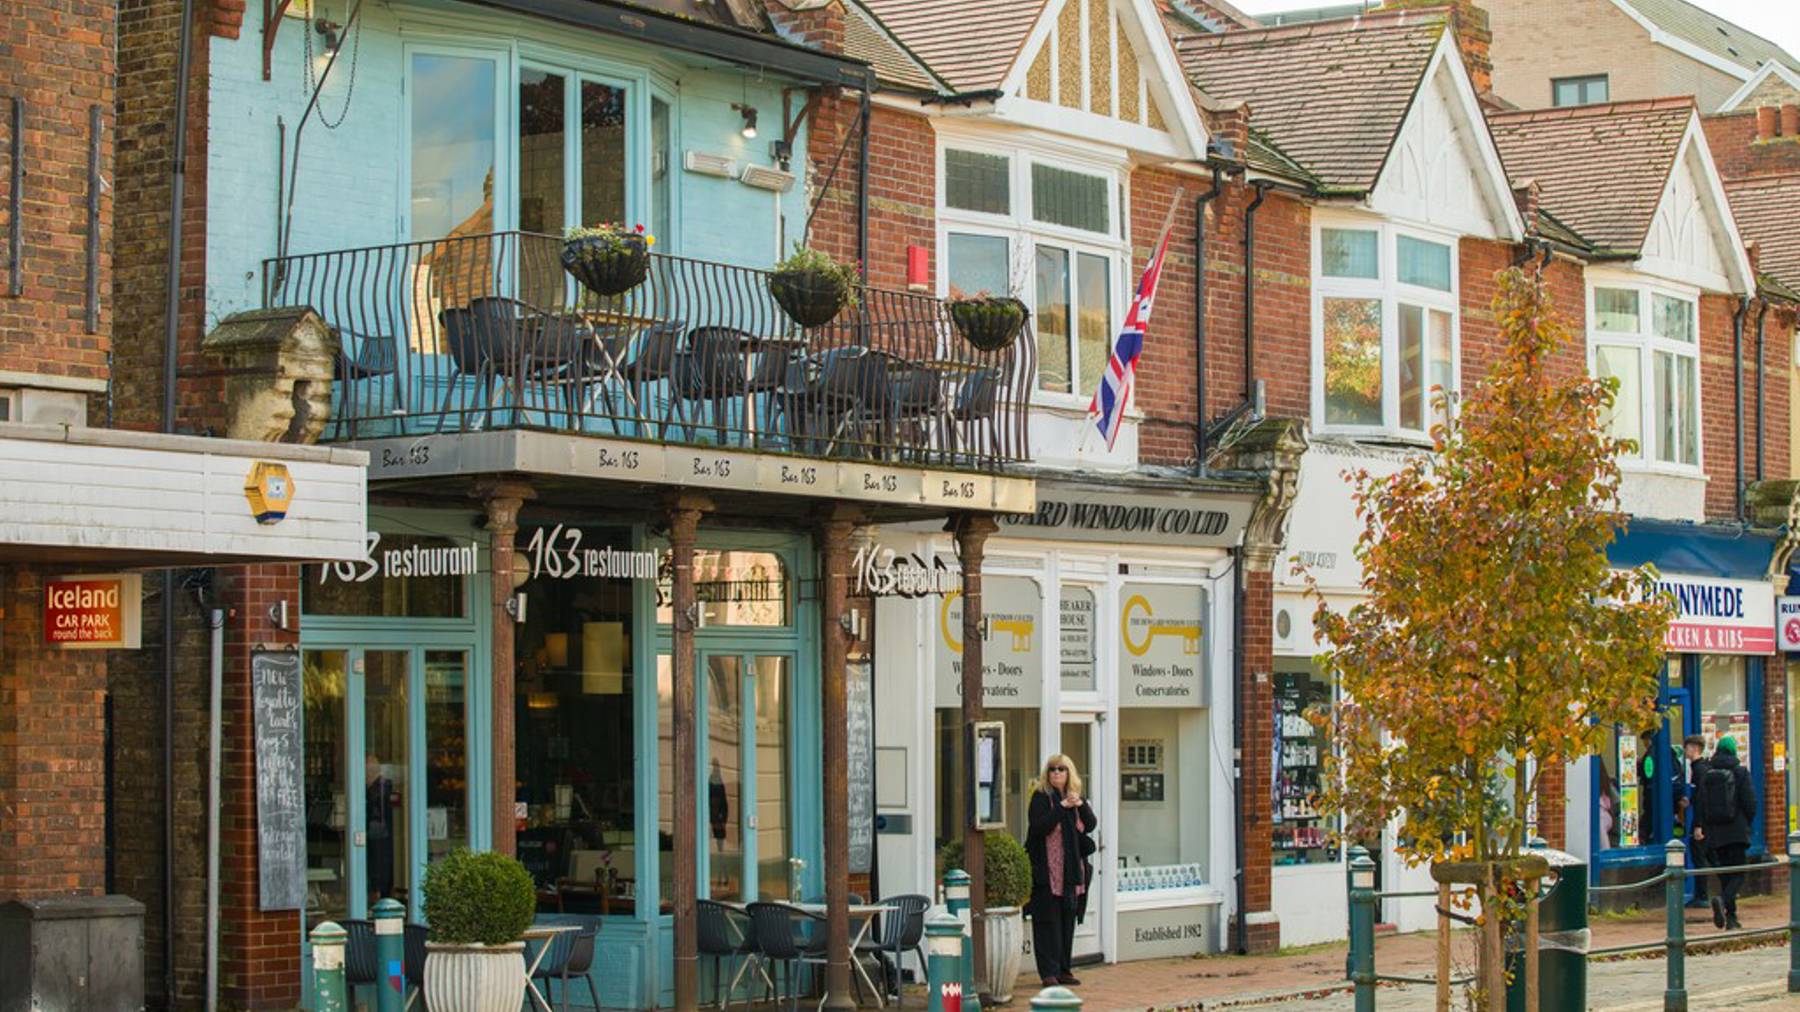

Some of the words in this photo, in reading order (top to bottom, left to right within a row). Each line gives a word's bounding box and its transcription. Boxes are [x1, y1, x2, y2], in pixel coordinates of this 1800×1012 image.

[382, 449, 404, 467] Bar
[410, 447, 430, 464] 163
[599, 449, 619, 468] Bar
[622, 451, 640, 470] 163
[693, 458, 712, 476] Bar
[715, 459, 731, 478] 163
[781, 466, 799, 483] Bar
[801, 468, 817, 485] 163
[864, 474, 880, 491] Bar
[883, 476, 897, 492] 163
[942, 481, 959, 498] Bar
[961, 482, 975, 499] 163
[1068, 503, 1161, 533] WINDOW
[1159, 508, 1192, 535] CO
[1190, 511, 1230, 536] LTD
[384, 541, 479, 578] restaurant
[528, 522, 583, 580] 163
[584, 545, 659, 578] restaurant
[852, 543, 896, 594] 163
[48, 584, 119, 609] Iceland
[56, 614, 79, 627] CAR
[81, 614, 110, 627] PARK
[53, 627, 78, 639] round
[79, 628, 93, 639] the
[94, 627, 113, 639] back
[1663, 626, 1700, 647] ICKEN
[1704, 629, 1713, 647] &
[1718, 630, 1744, 648] RIBS
[998, 662, 1023, 676] Doors
[1132, 664, 1166, 677] Windows
[1172, 664, 1194, 677] Doors
[957, 684, 1018, 697] Crvatories
[1136, 683, 1190, 697] Conservatories
[1135, 925, 1182, 943] Established
[1183, 923, 1202, 939] 1982
